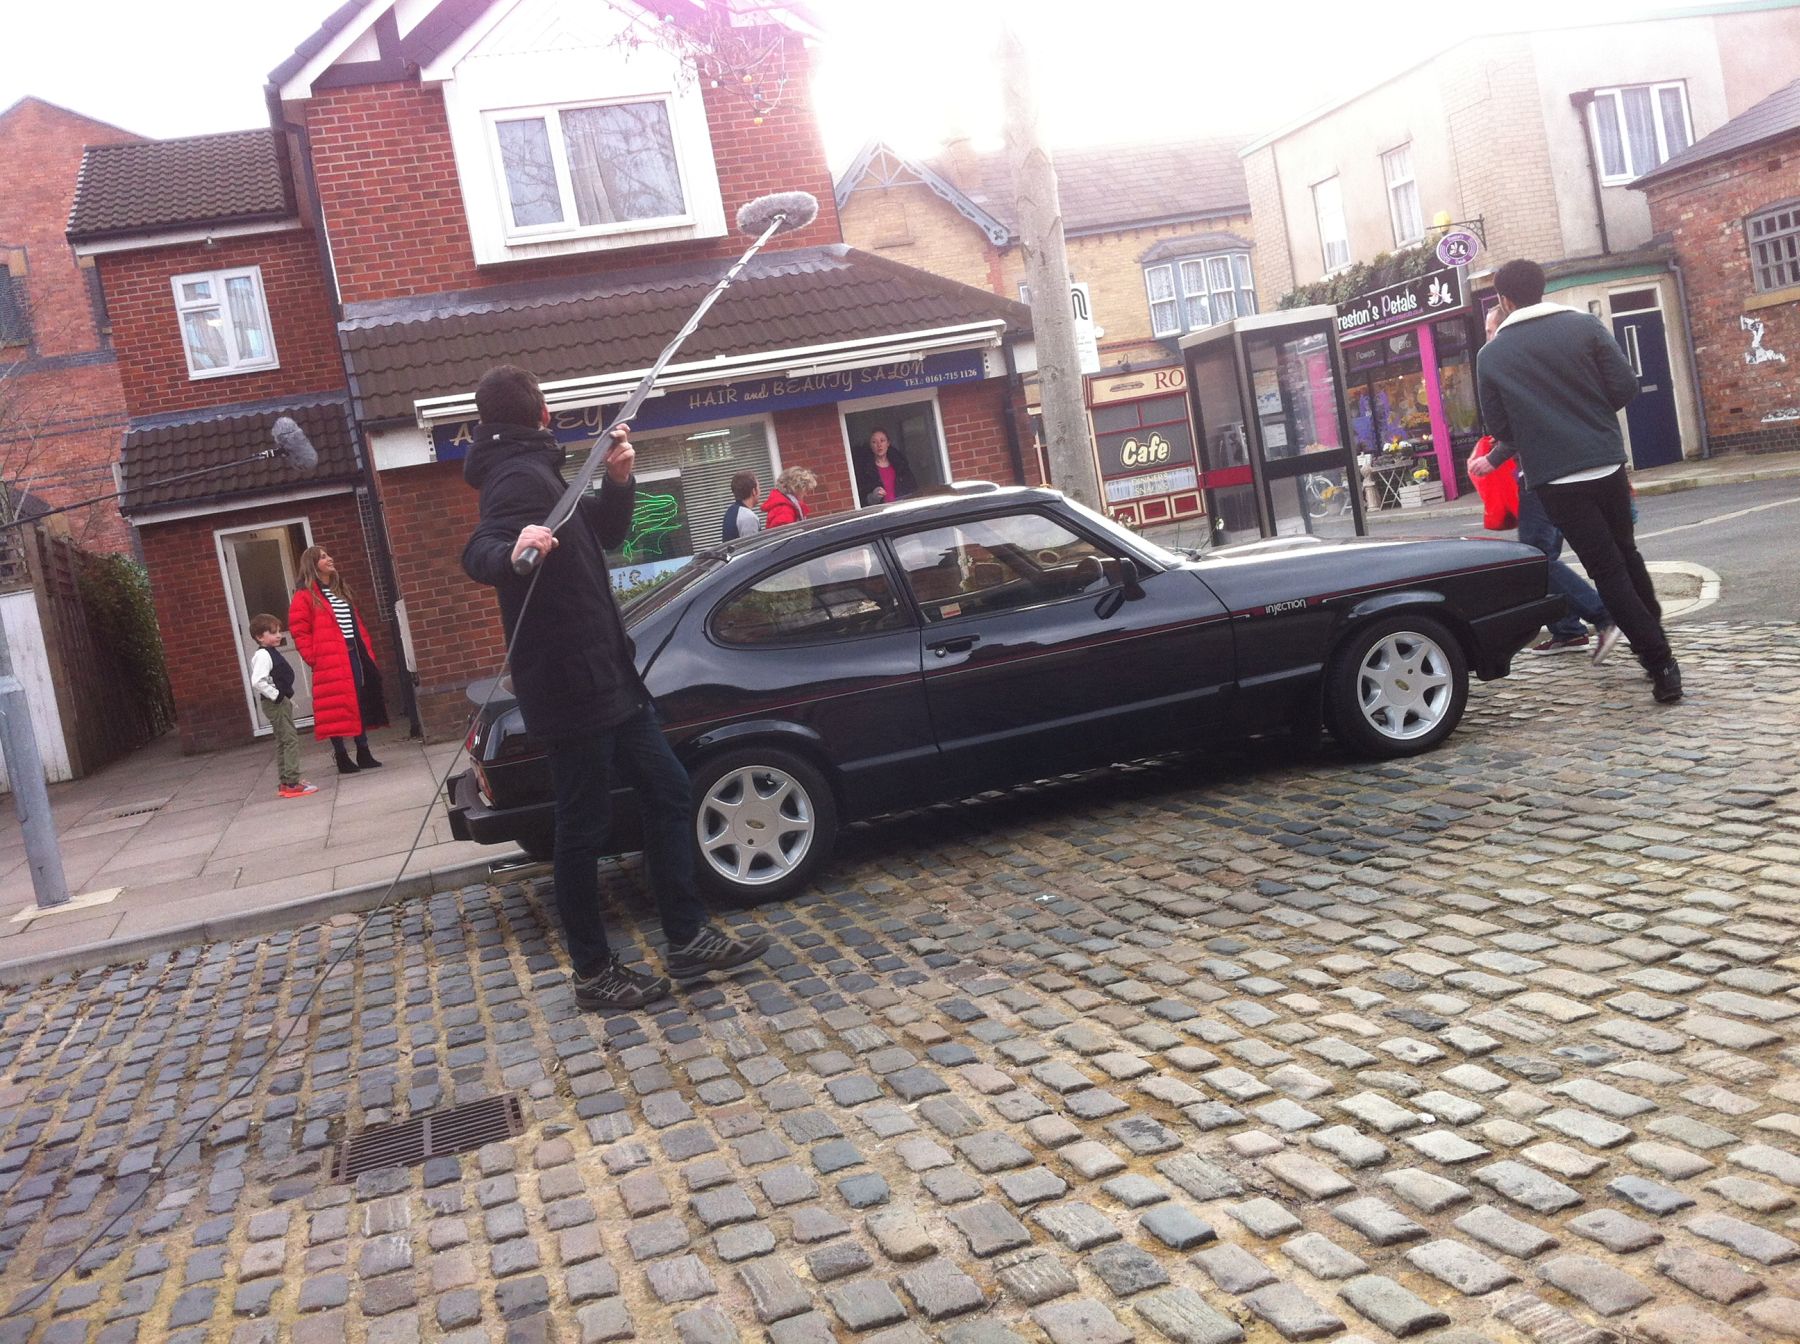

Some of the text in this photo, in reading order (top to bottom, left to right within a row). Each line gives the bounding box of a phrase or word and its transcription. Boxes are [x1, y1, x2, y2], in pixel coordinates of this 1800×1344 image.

[1337, 300, 1380, 331] reston's
[1380, 288, 1418, 317] Petals
[688, 359, 926, 410] HAIR and BEAUTY SALON
[925, 372, 959, 384] 0161-715
[960, 368, 978, 379] 1126
[1122, 434, 1169, 466] Cafe
